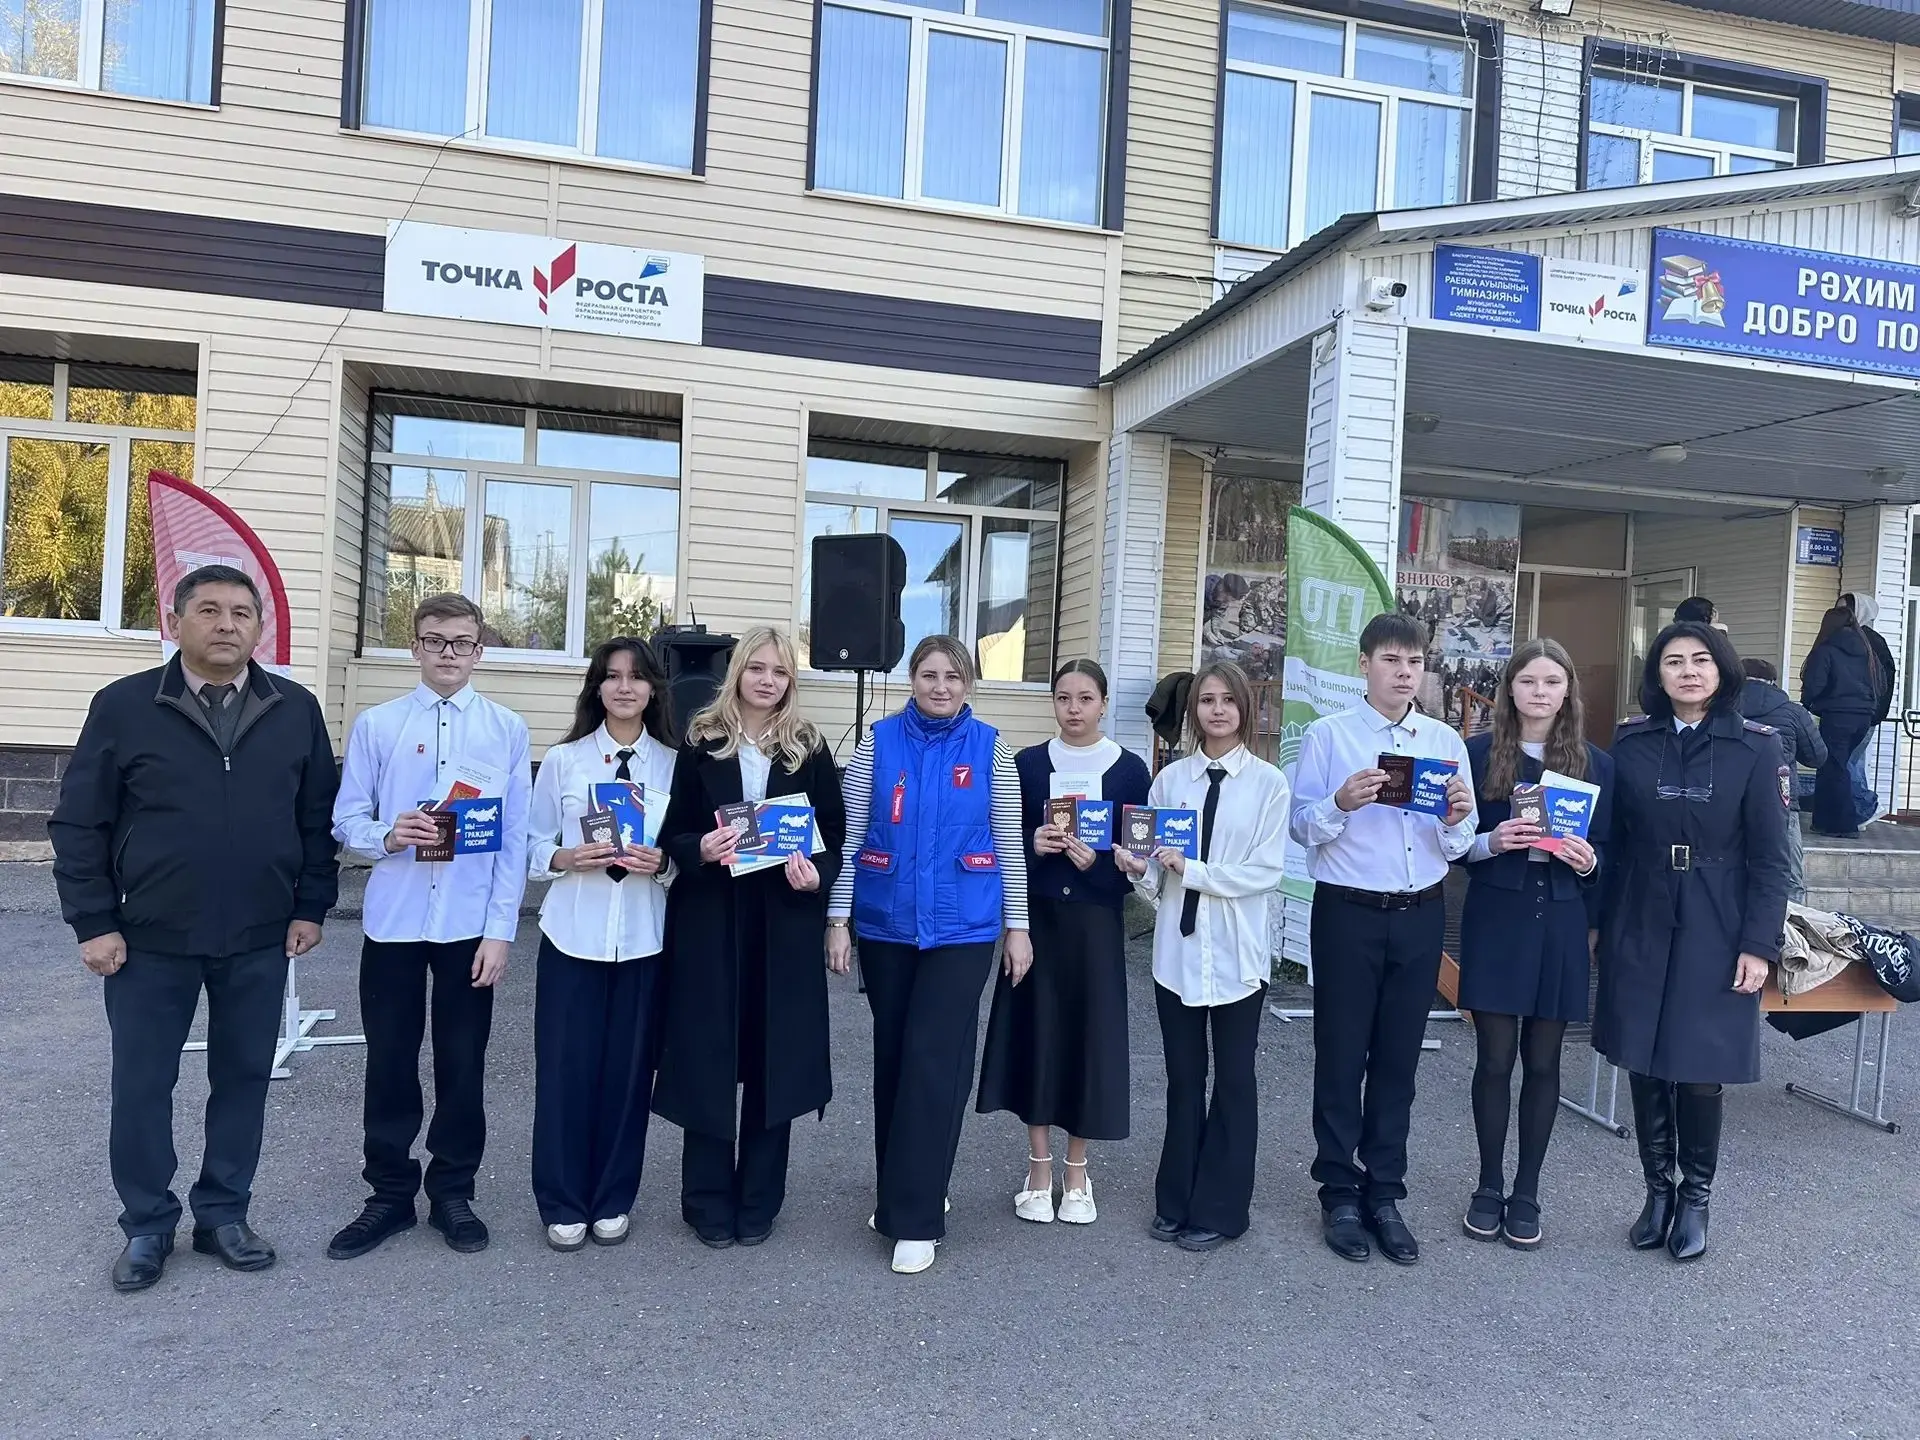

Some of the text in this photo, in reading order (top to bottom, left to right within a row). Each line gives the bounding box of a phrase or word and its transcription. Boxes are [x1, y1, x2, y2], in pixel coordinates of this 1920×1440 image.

[421, 260, 668, 307] ТОЧКА РОСТА
[1445, 276, 1478, 287] РАЕВКА
[1797, 267, 1915, 312] РӘХИМ
[1550, 302, 1637, 322] ТОЧКА РОСТА
[1743, 301, 1857, 344] ДОБРО
[1397, 572, 1450, 587] вника
